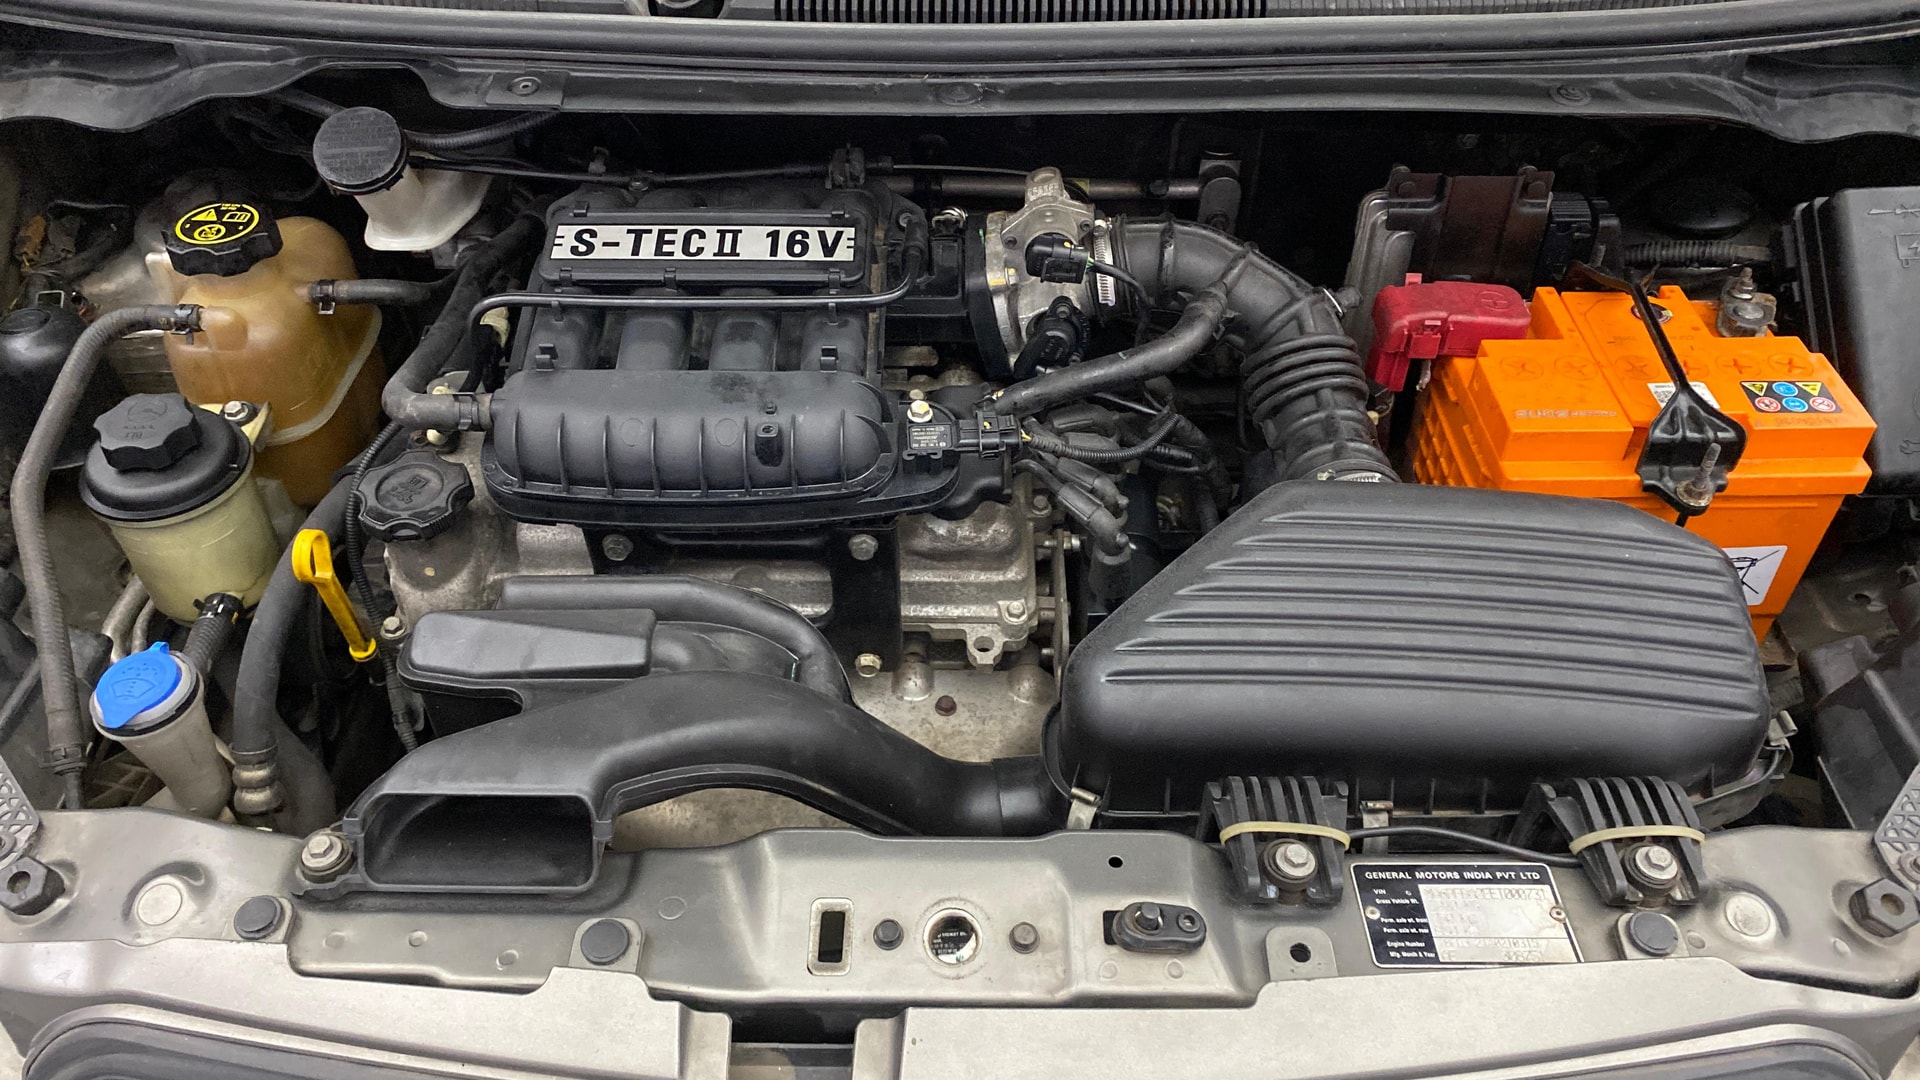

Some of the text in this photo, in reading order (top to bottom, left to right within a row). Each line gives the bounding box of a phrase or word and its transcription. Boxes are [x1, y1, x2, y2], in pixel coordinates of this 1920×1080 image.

[765, 229, 845, 258] 16V
[1364, 871, 1541, 880] GENERAL MOTORS INDIA PVT LTD
